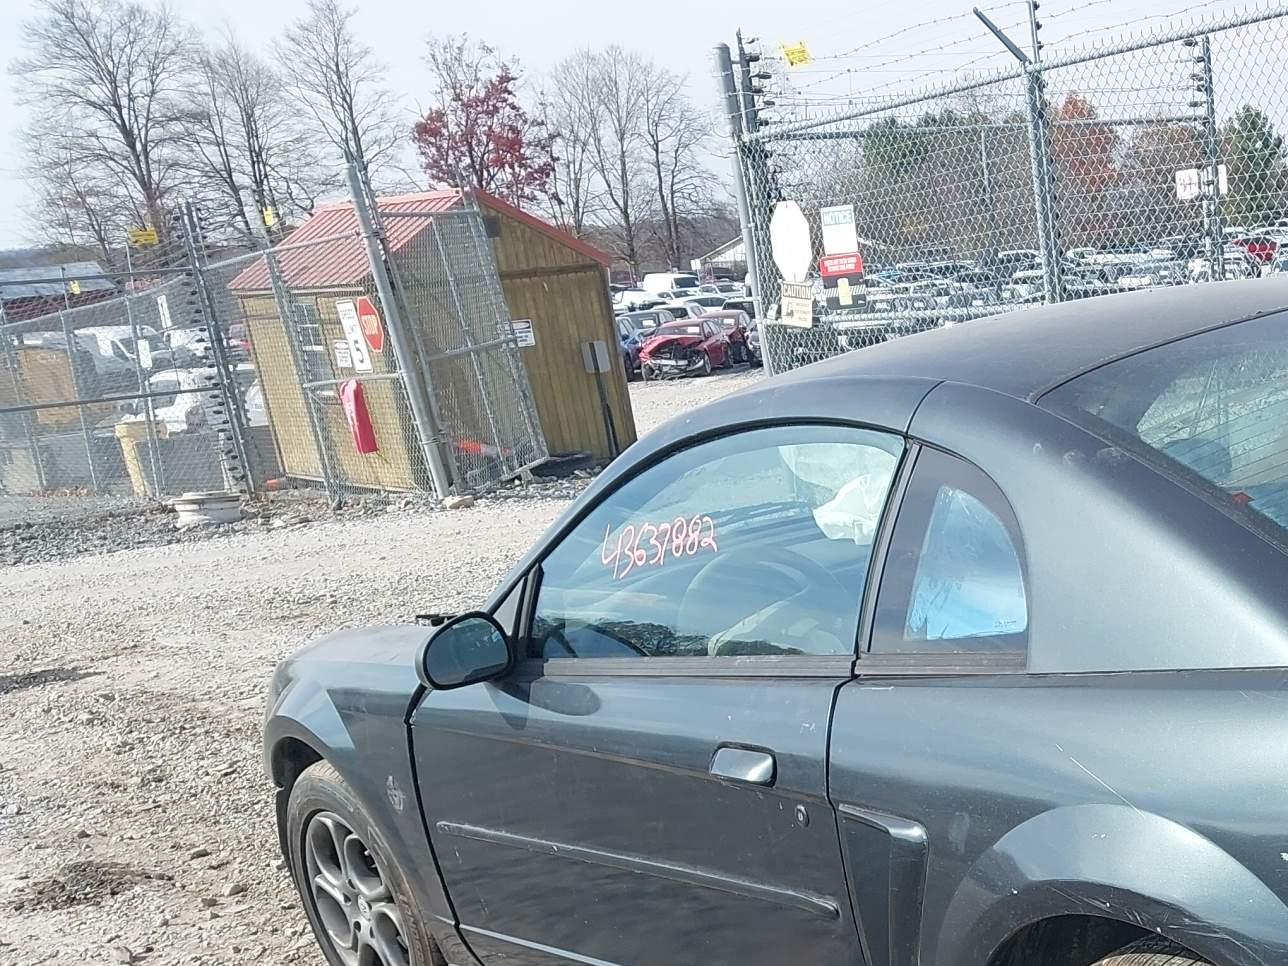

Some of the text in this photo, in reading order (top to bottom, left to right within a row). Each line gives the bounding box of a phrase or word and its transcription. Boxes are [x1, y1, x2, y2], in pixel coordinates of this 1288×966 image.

[783, 284, 811, 299] CAUTION
[361, 314, 379, 336] STOP
[601, 514, 718, 580] 43637882
